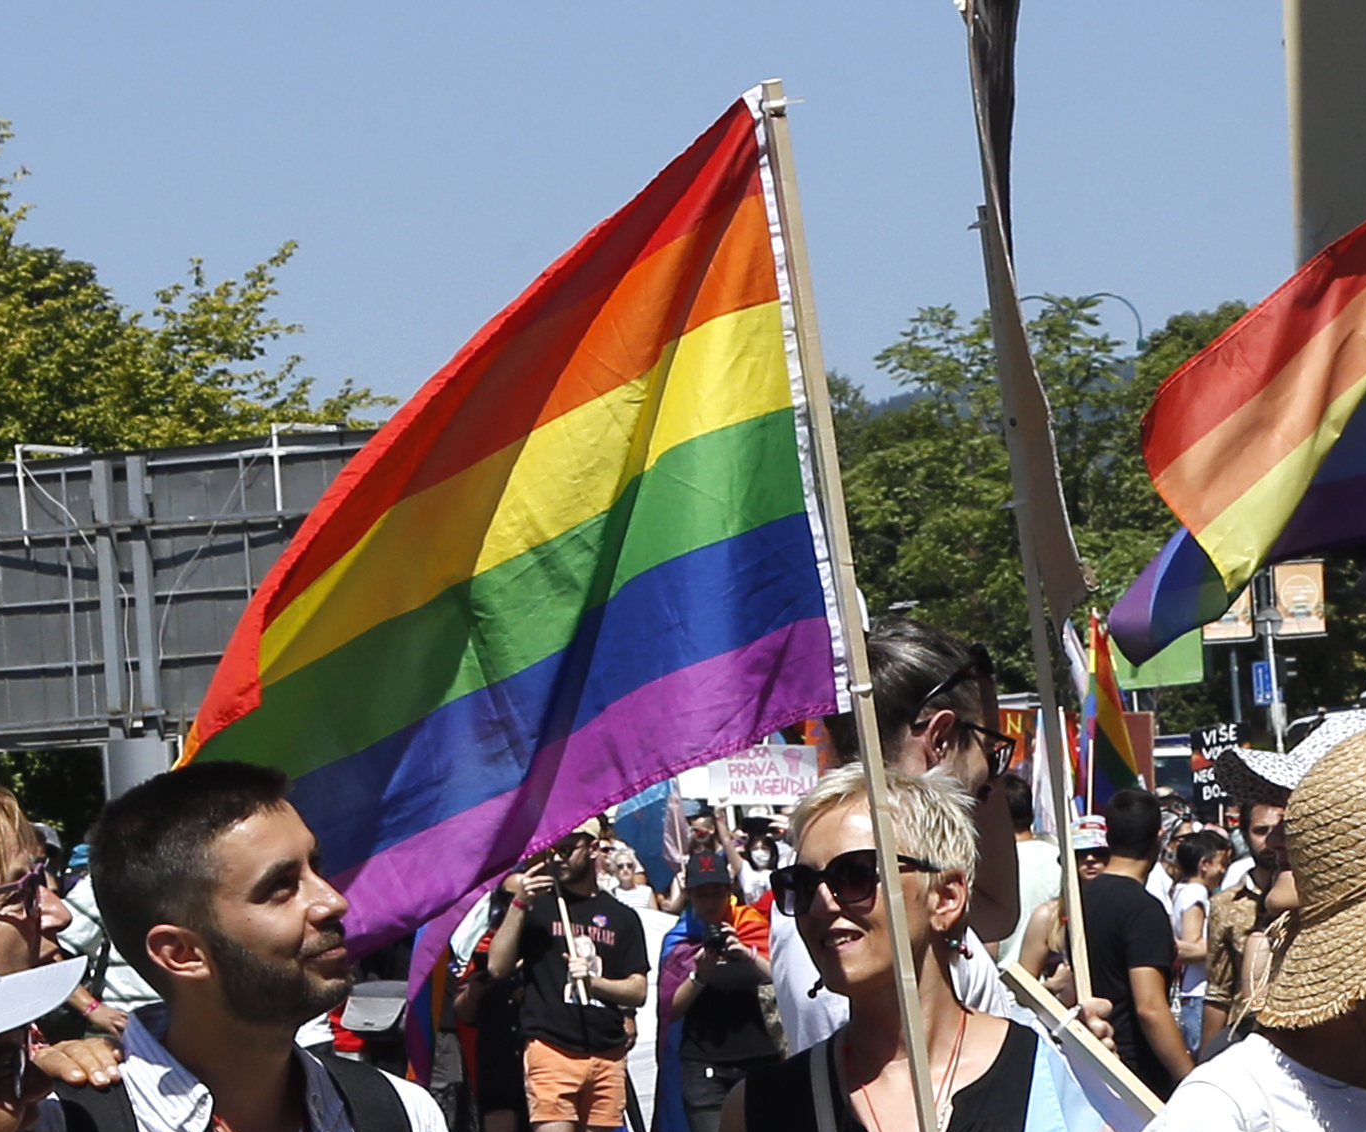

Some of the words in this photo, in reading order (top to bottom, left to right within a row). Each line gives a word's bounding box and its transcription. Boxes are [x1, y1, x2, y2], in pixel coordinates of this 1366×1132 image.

[727, 761, 780, 777] PRAVA
[730, 781, 748, 795] NA
[752, 776, 815, 796] AGENDU
